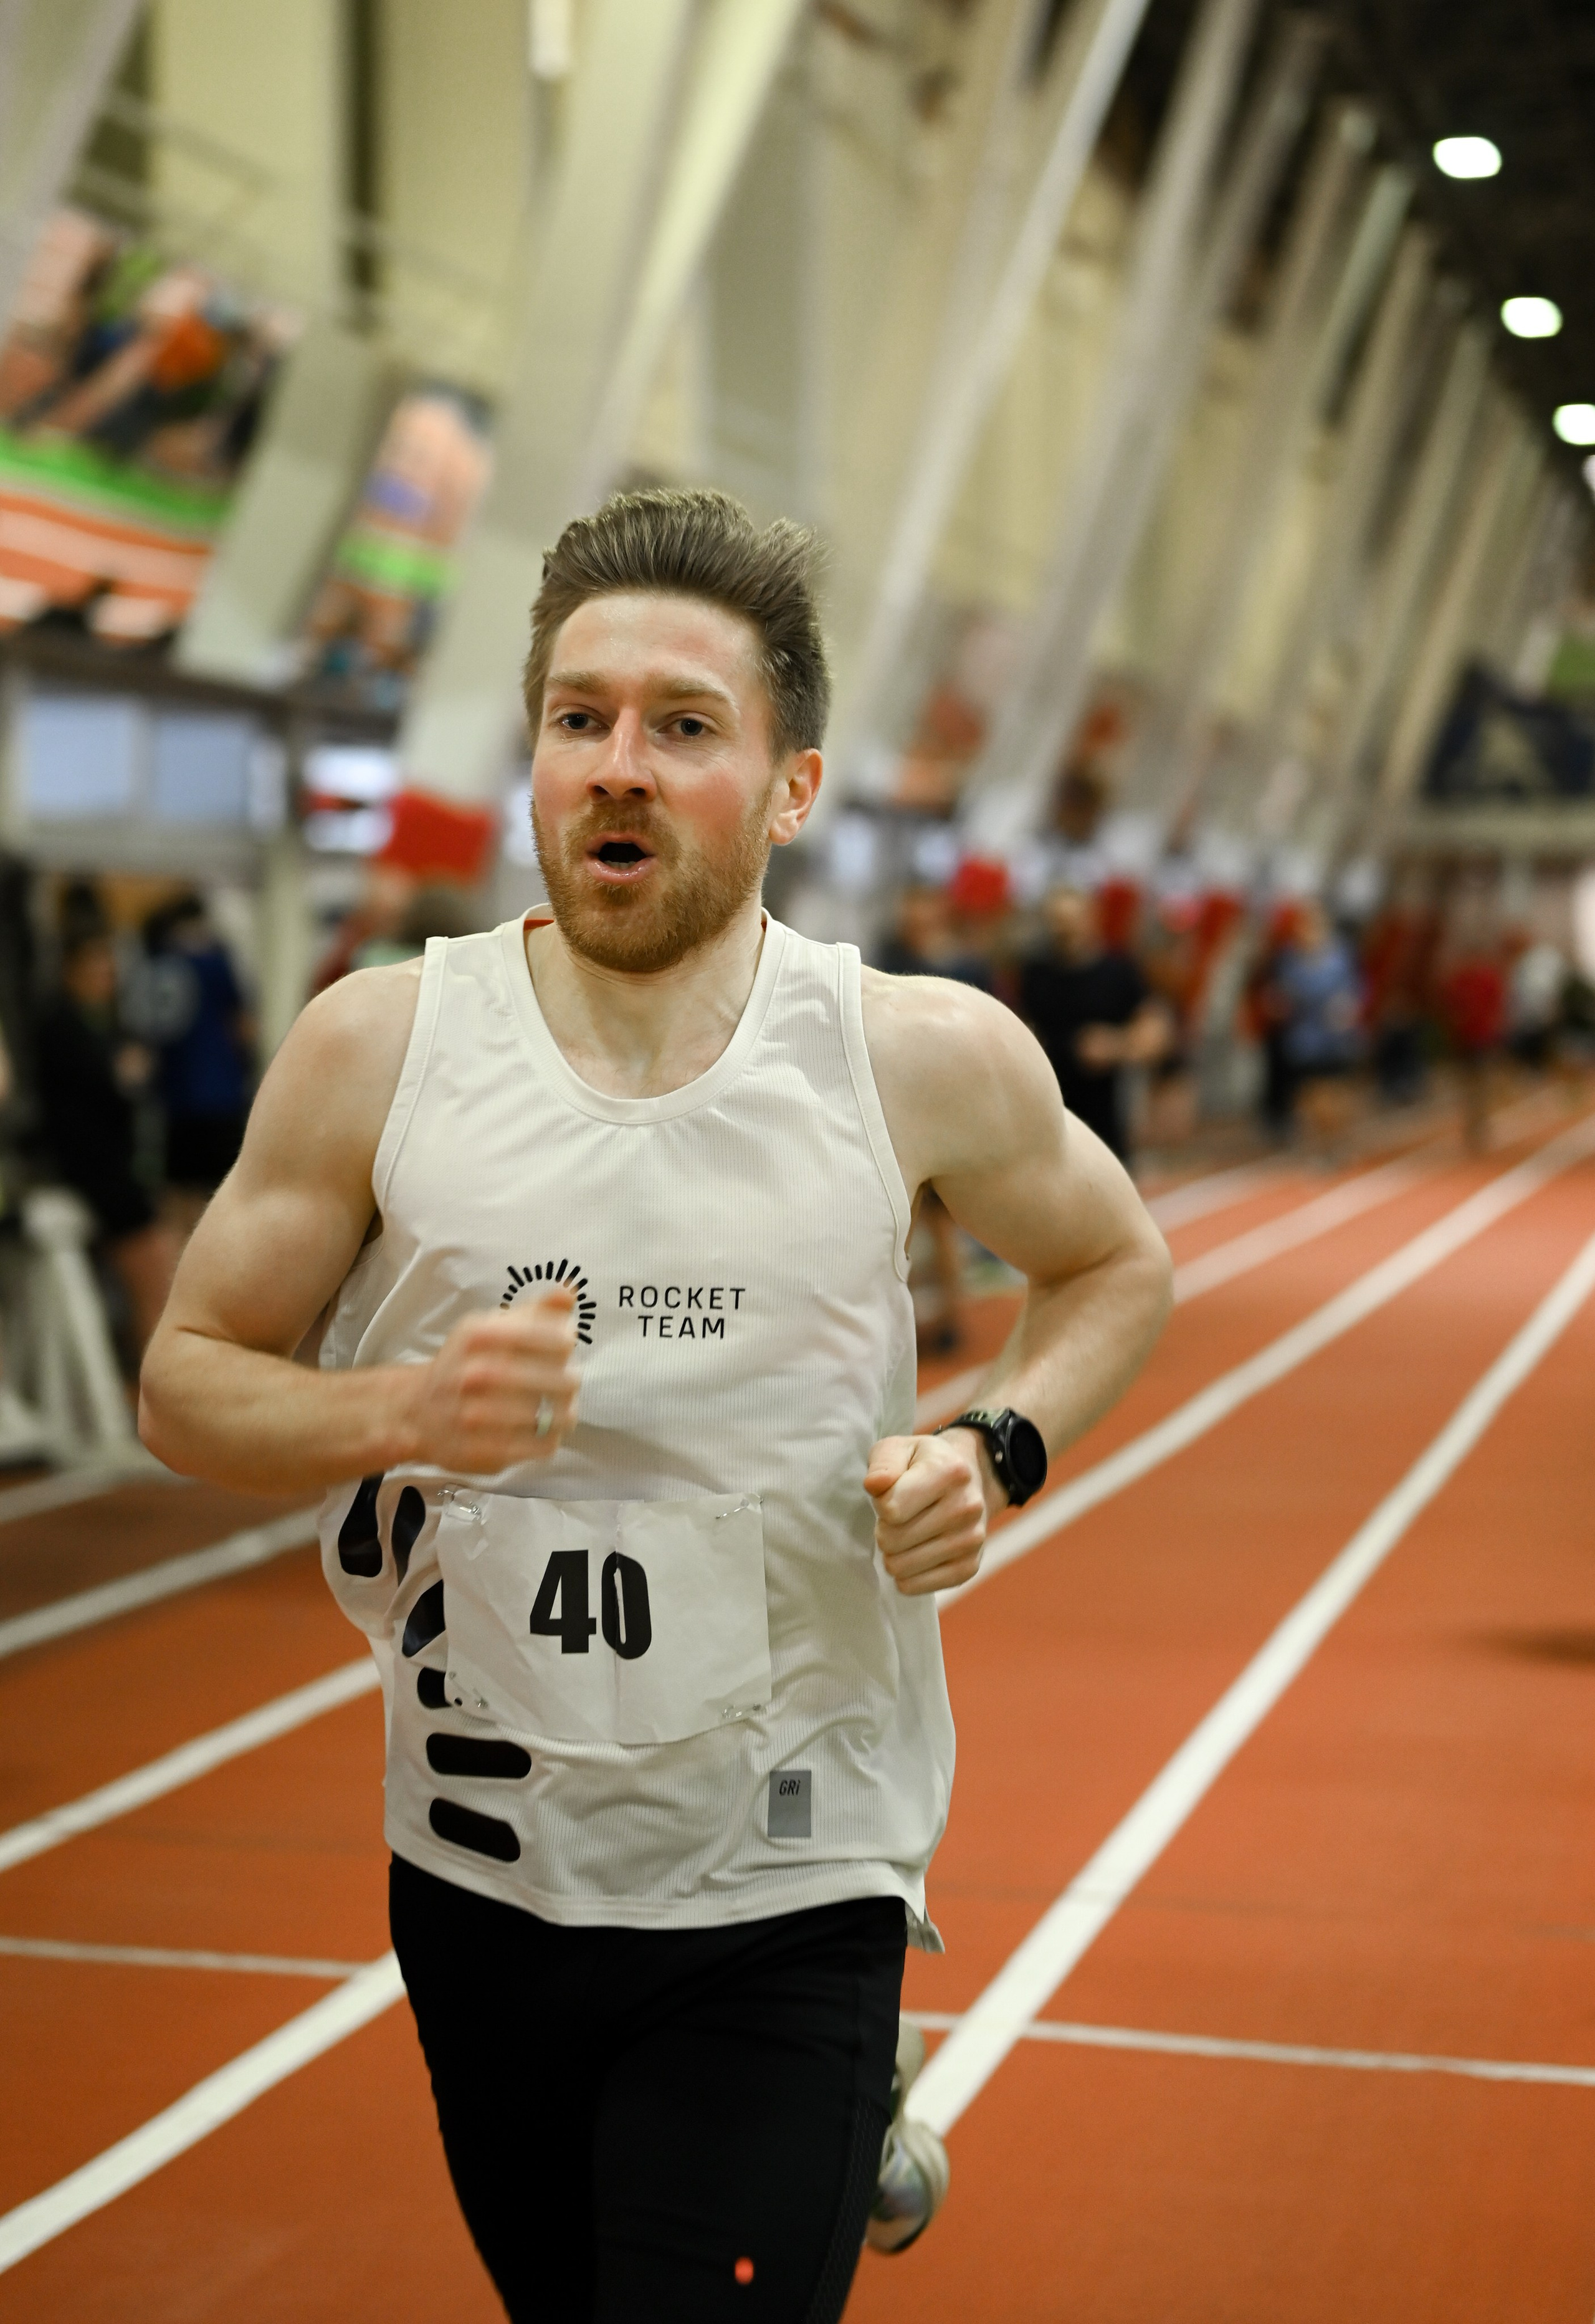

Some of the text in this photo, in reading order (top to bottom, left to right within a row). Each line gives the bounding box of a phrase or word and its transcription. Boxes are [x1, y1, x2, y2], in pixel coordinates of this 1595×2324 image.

[619, 1285, 746, 1310] ROCKET
[637, 1315, 725, 1339] TEAM
[530, 1549, 652, 1660] 40
